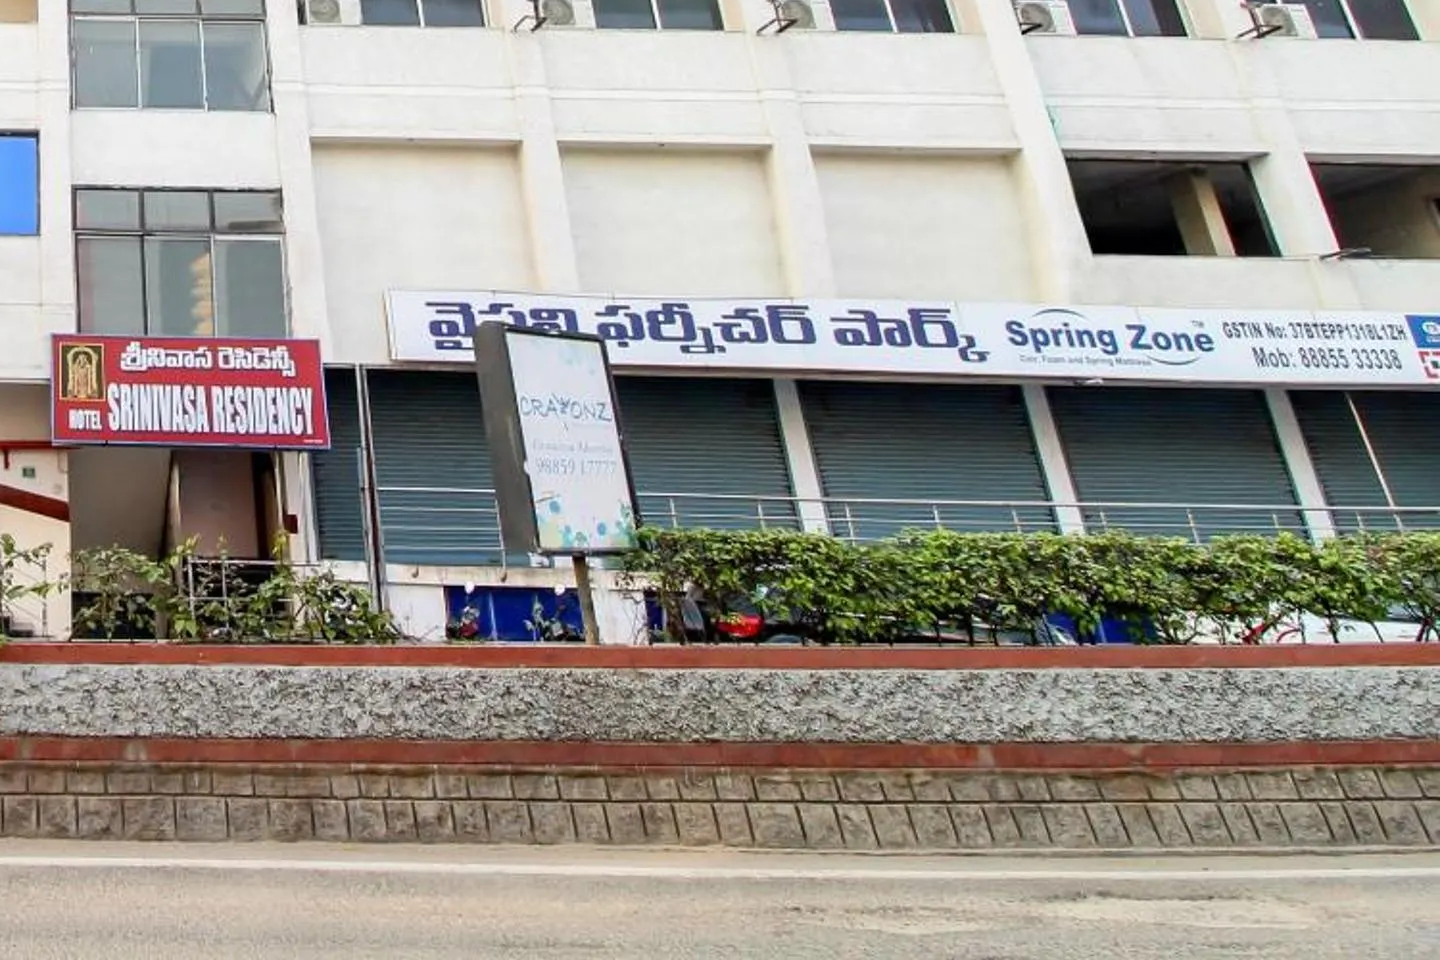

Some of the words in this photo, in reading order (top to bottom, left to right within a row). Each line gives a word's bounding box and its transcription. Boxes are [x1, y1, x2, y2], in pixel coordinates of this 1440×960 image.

[1006, 320, 1119, 355] Spring
[1126, 324, 1215, 352] Zone
[1222, 322, 1262, 339] GSTIN
[1264, 323, 1287, 338] No:
[1251, 346, 1297, 368] Mob:
[1298, 347, 1349, 368] 88855
[1351, 348, 1403, 370] 33338
[69, 409, 102, 429] HOTEL
[108, 383, 209, 433] SRINIVASA
[212, 386, 313, 435] RESIDENCY
[520, 393, 612, 422] CRAYONZ
